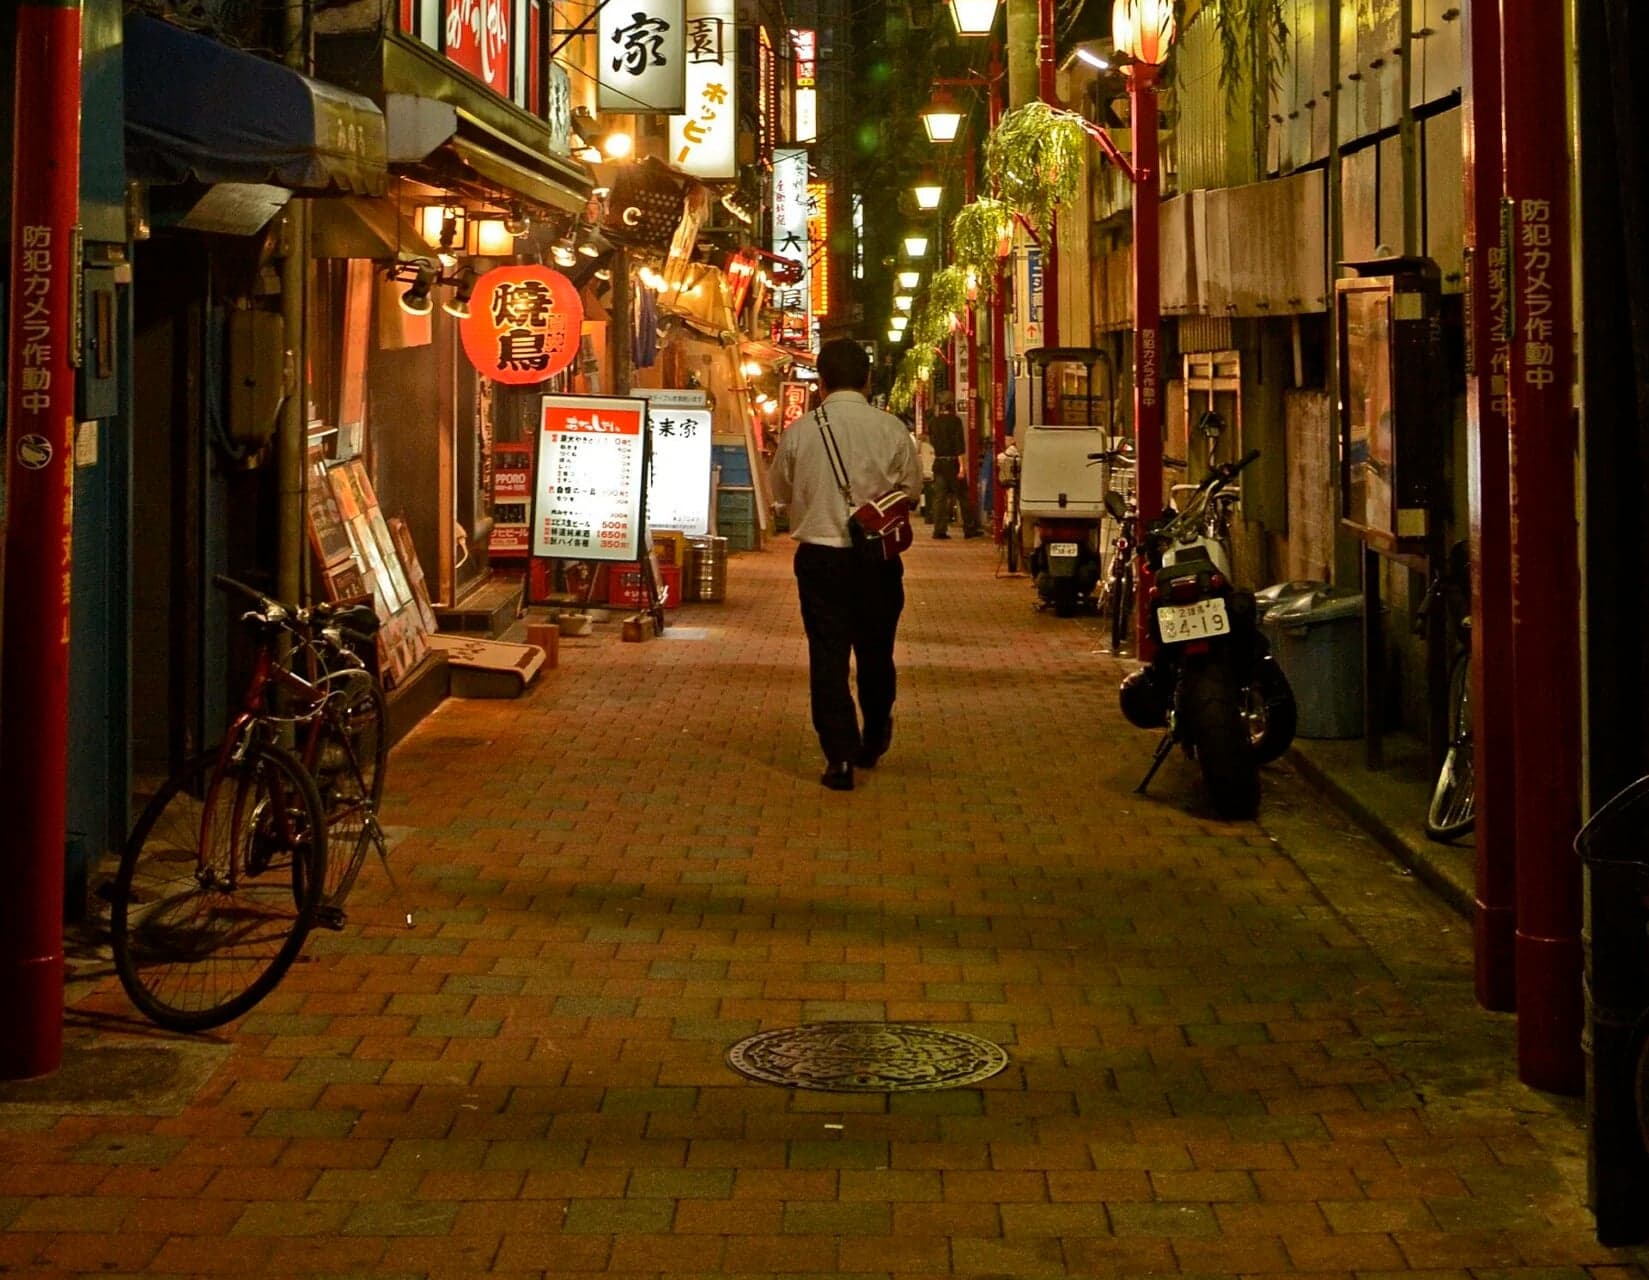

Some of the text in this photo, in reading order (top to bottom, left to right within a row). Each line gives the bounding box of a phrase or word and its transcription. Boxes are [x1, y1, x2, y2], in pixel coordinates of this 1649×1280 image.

[610, 12, 671, 76] 家
[676, 82, 728, 163] ホッピー
[779, 230, 803, 312] 大屋
[1521, 198, 1555, 390] 防犯カメラ作動中
[21, 224, 52, 415] 防犯カメラ作動中
[491, 280, 553, 371] 焼鳥
